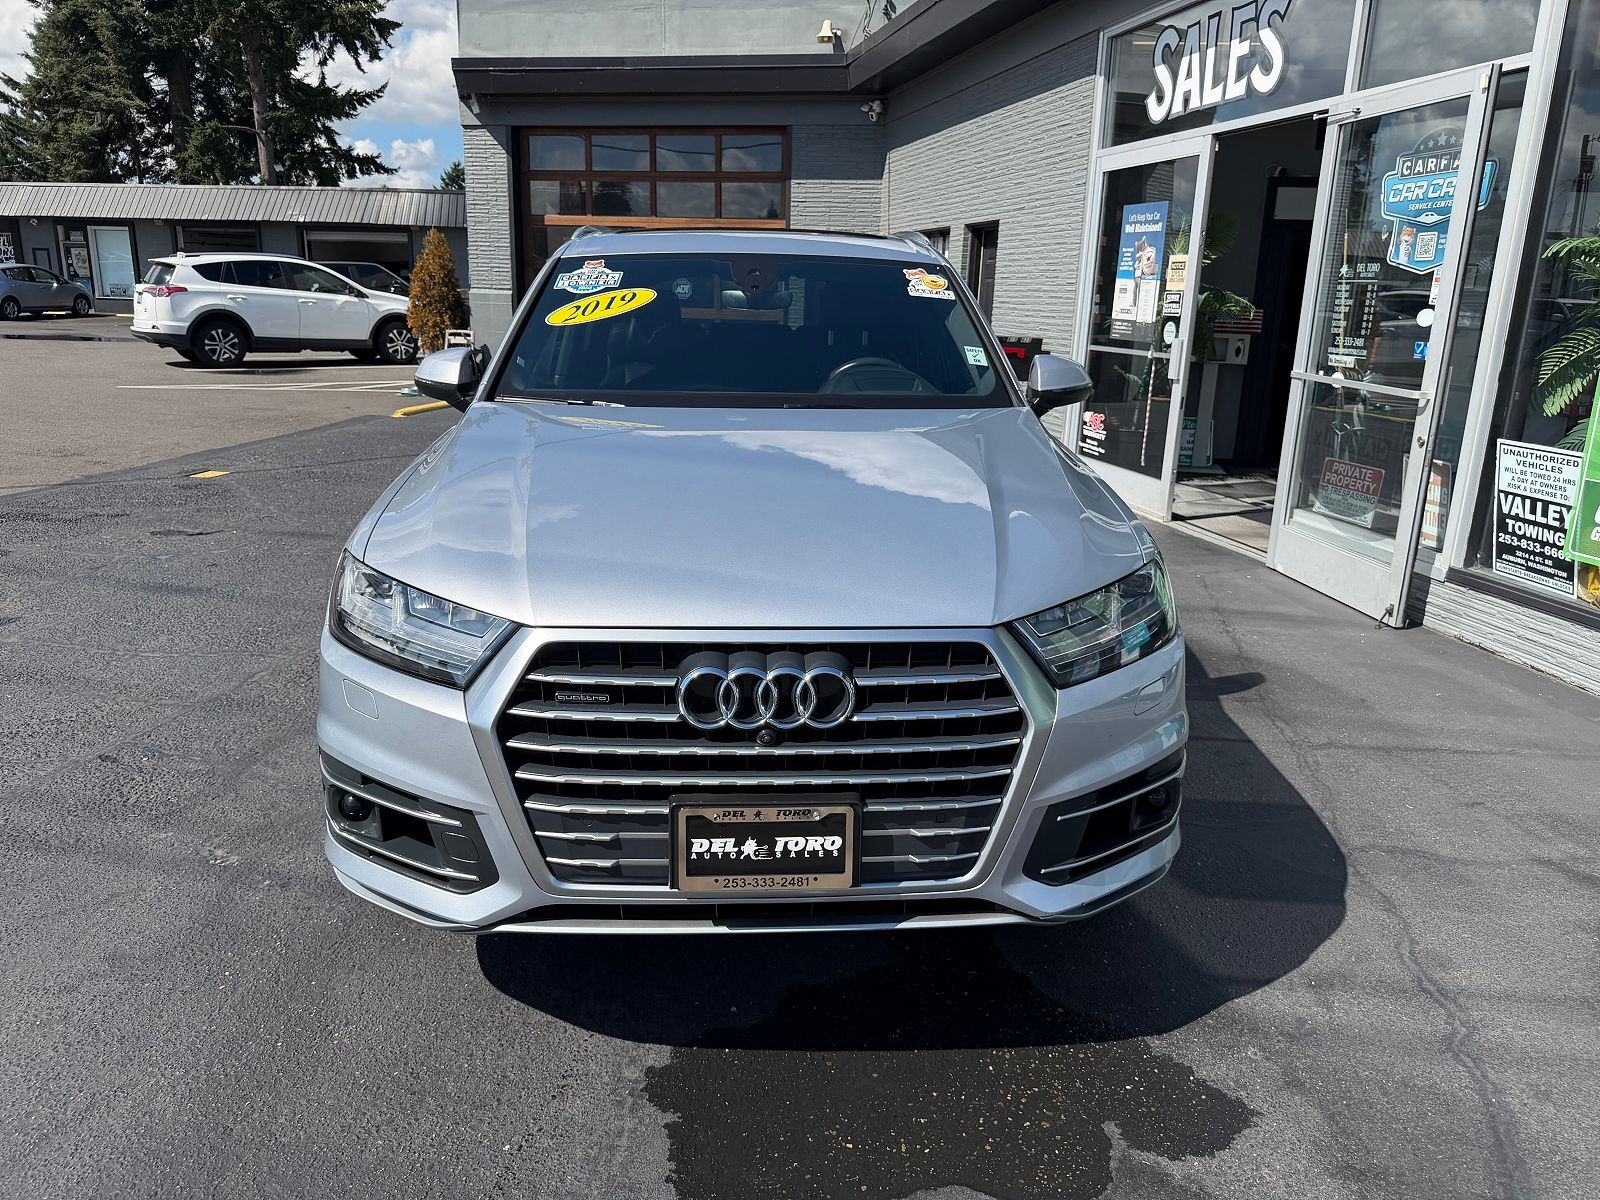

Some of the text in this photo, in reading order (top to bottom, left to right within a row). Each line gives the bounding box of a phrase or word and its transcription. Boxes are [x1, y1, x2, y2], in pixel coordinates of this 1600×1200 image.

[1145, 0, 1291, 124] SALES
[1402, 153, 1461, 176] CARFA
[1388, 177, 1458, 203] CAR CA
[1407, 199, 1454, 211] SERVICE CENTE
[676, 285, 689, 293] ADT
[562, 292, 637, 323] 2019
[1503, 448, 1579, 468] UNAUTHORIZED
[1516, 459, 1563, 474] VEHICLES
[1332, 462, 1374, 481] PRIVATE
[1504, 466, 1518, 475] WILL
[1530, 471, 1551, 481] TOWED
[1553, 475, 1560, 483] 24
[1562, 477, 1576, 486] HRS
[1324, 471, 1377, 494] PROPERTY
[1507, 482, 1521, 491] RISK
[1530, 487, 1558, 498] EXPENSE
[1559, 493, 1570, 501] TO:
[1517, 476, 1529, 484] DAY
[1540, 481, 1567, 493] OWNERS
[1330, 486, 1376, 505] TRESPASSING
[1499, 493, 1574, 530] VALLEY
[1505, 518, 1566, 546] TOWING
[1502, 553, 1527, 567] AUBURN,
[1528, 560, 1568, 578] WASHINGTON
[1515, 550, 1529, 559] 3214
[1544, 558, 1553, 566] SE
[721, 808, 811, 818] DEL TORO
[690, 835, 843, 853] DEL TORO
[690, 850, 839, 860] AUTO SALES
[723, 876, 810, 889] 253-333-2481
